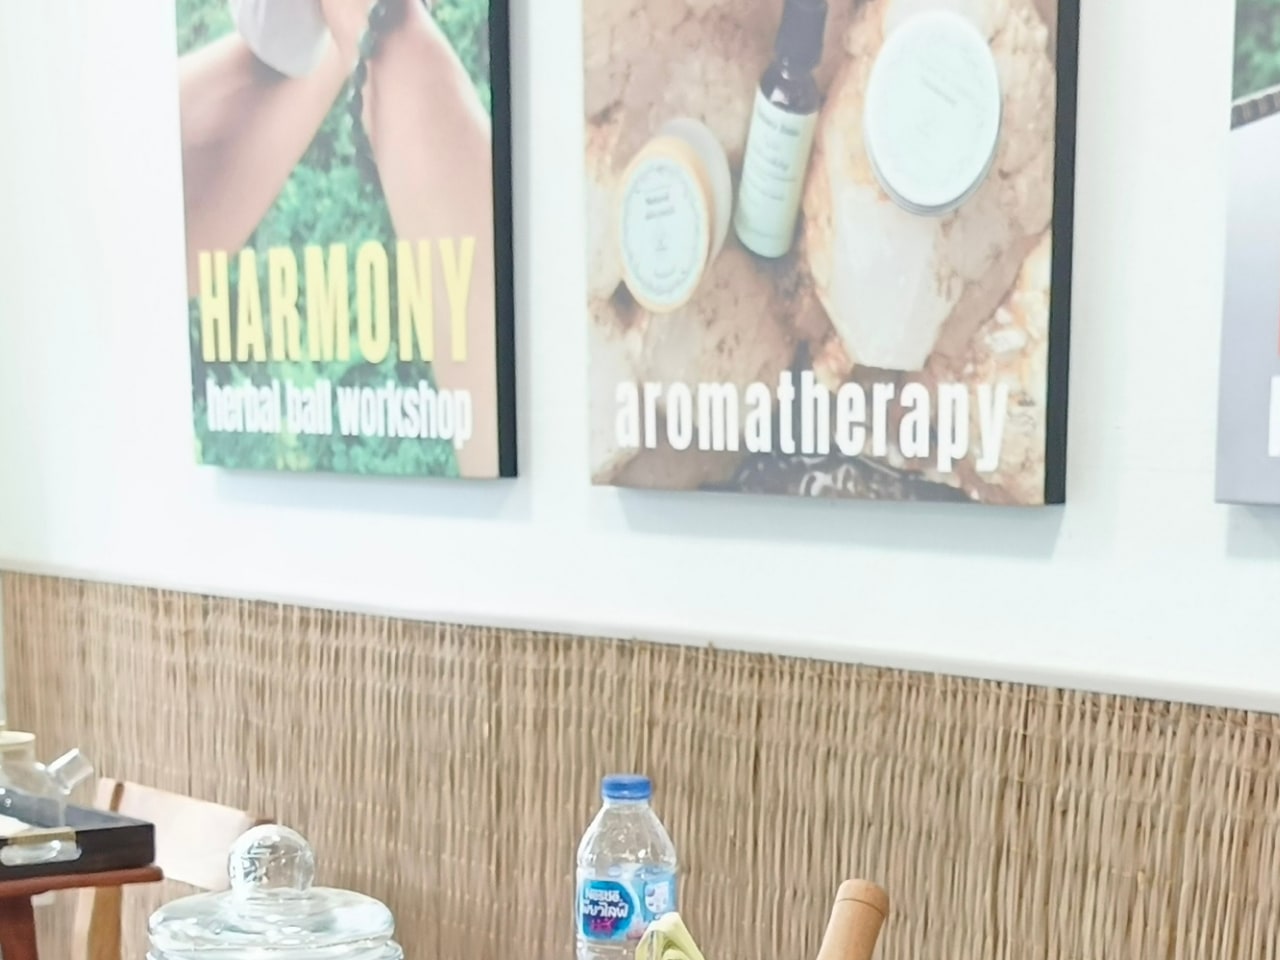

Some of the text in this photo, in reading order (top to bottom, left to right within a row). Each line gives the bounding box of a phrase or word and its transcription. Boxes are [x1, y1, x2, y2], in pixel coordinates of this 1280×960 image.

[198, 237, 475, 363] HARMONY
[206, 378, 472, 450] herbal ball workshop
[614, 370, 1009, 473] aromatherapy
